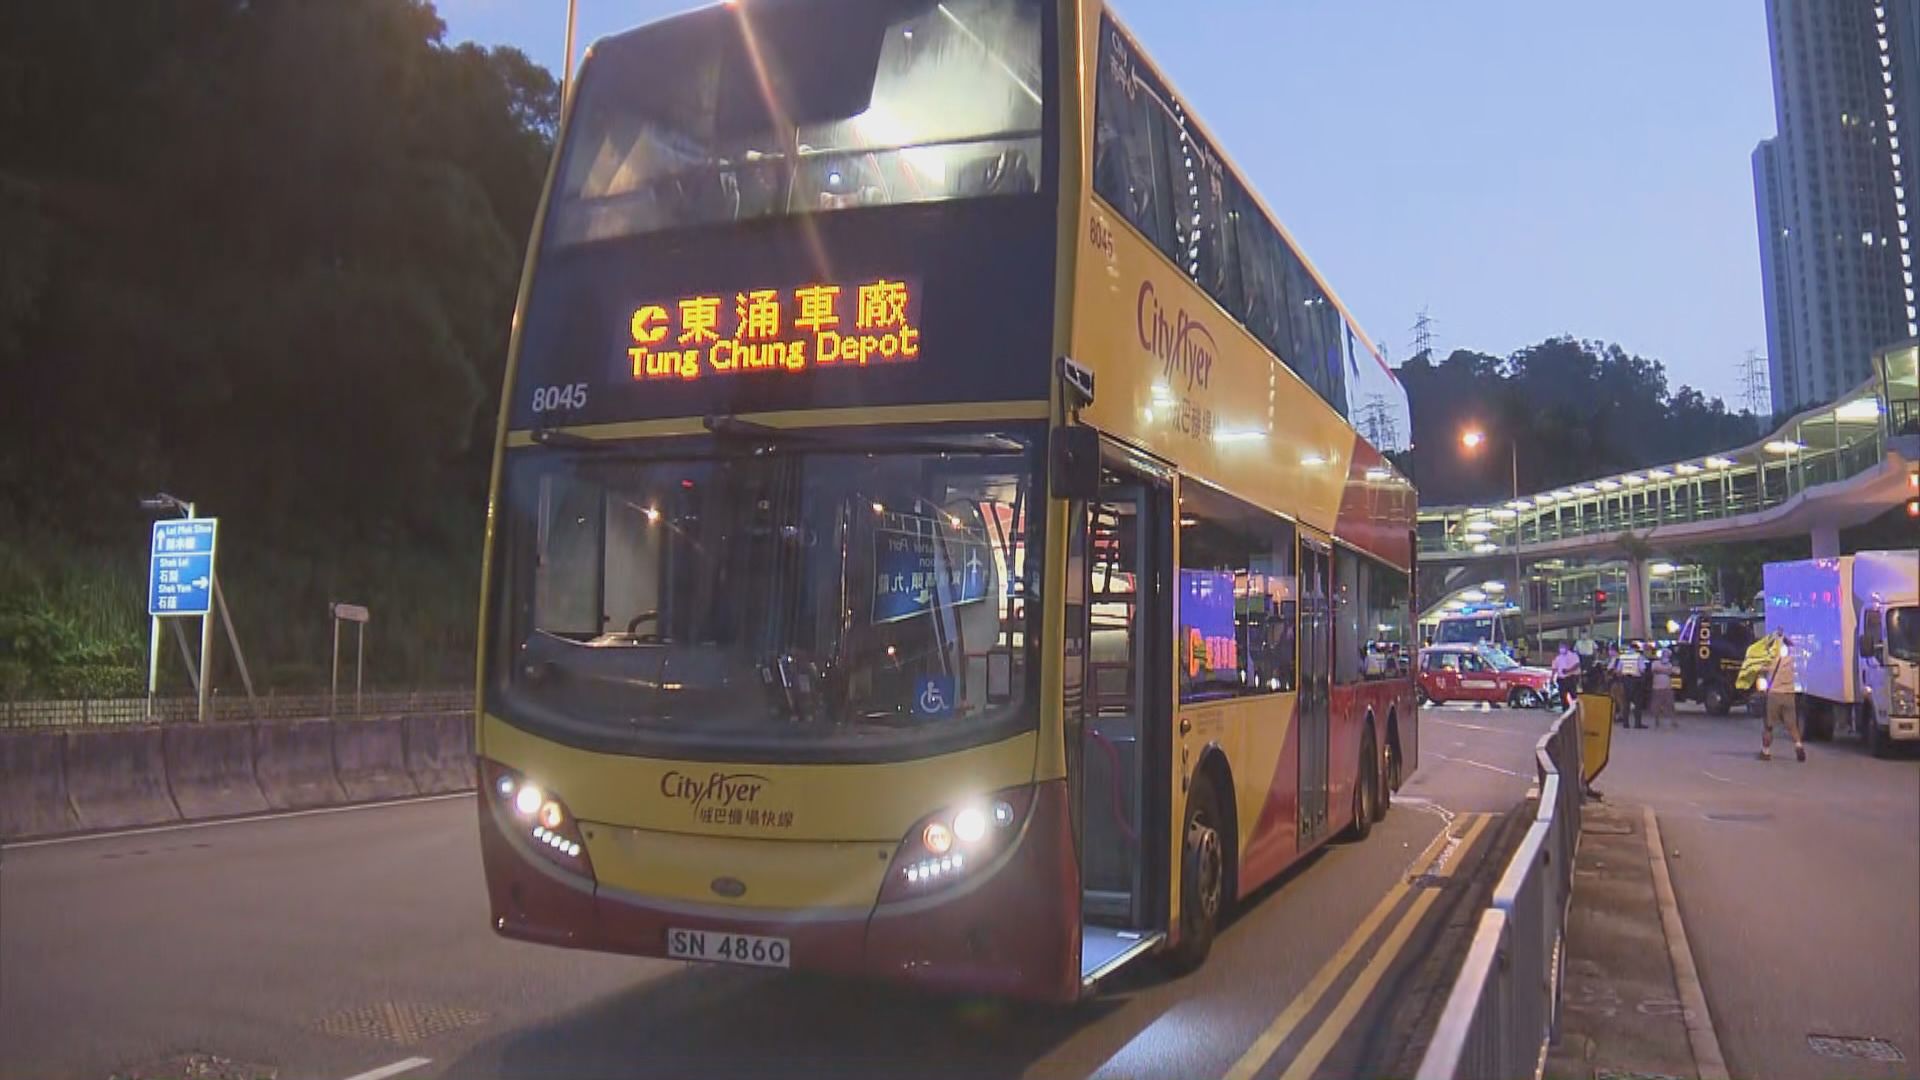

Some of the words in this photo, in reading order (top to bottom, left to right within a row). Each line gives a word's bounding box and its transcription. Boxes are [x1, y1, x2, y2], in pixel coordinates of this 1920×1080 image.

[677, 279, 912, 345] 東涌車廠
[627, 346, 701, 379] Tung
[709, 339, 807, 370] Chung
[816, 324, 919, 365] Depot
[531, 382, 589, 412] 8045
[674, 931, 705, 956] SN
[717, 936, 785, 963] 4860
